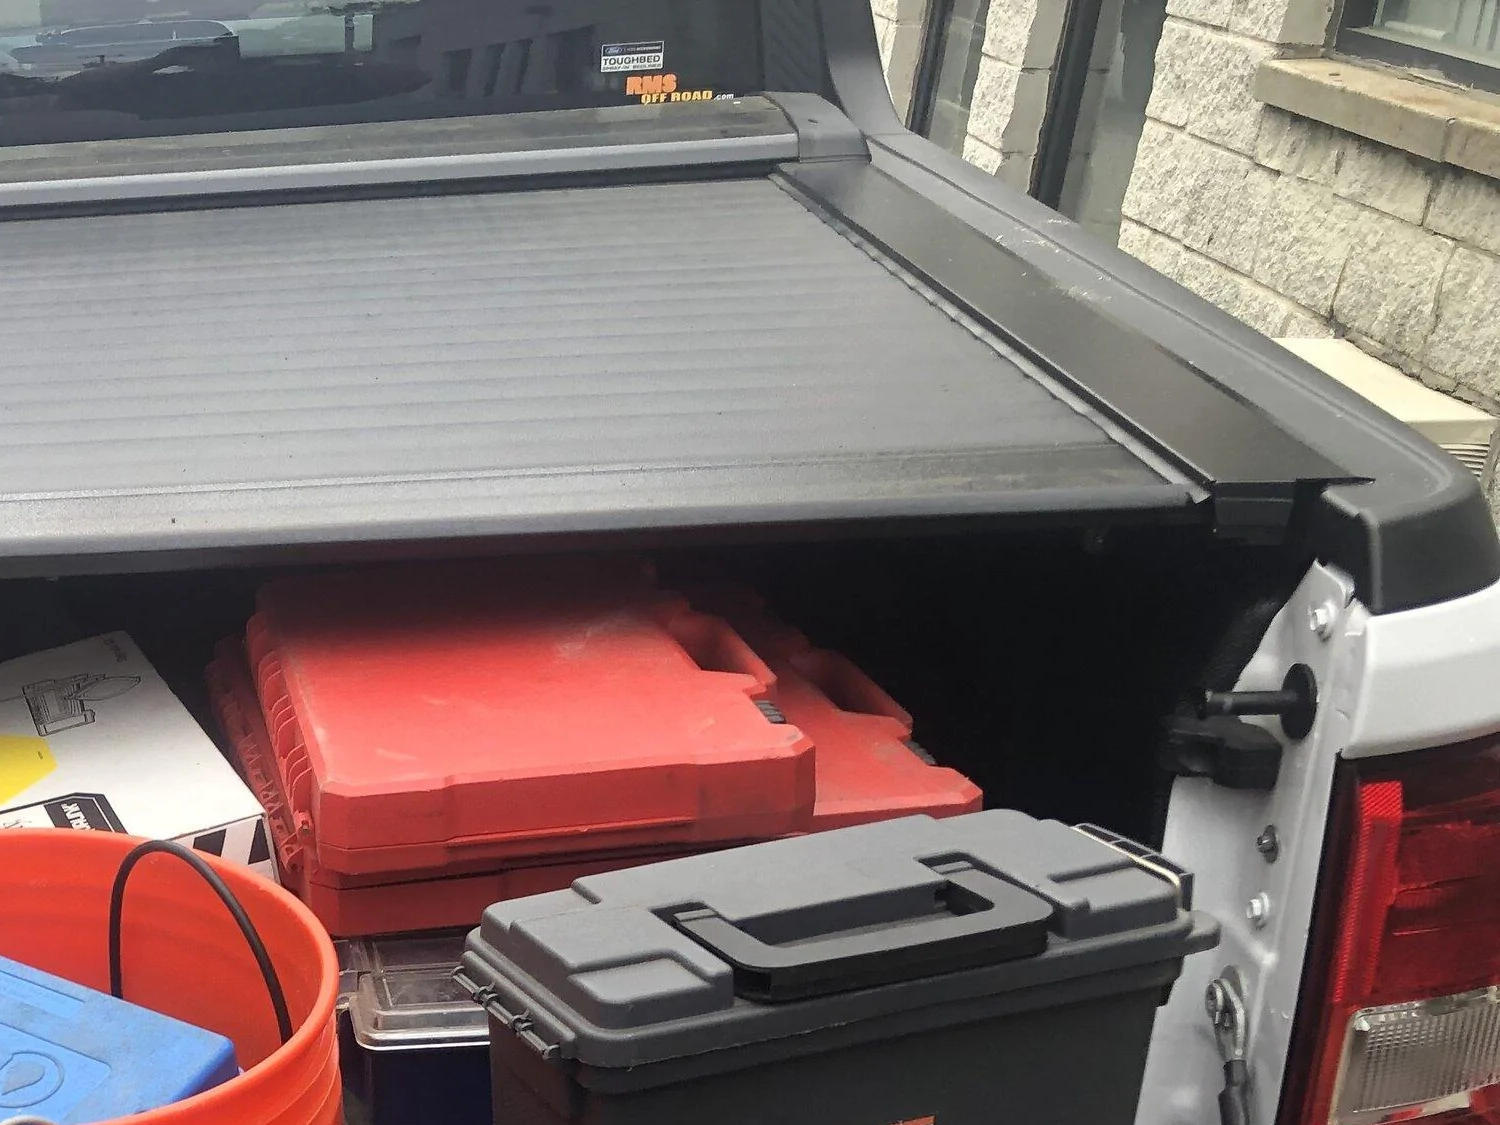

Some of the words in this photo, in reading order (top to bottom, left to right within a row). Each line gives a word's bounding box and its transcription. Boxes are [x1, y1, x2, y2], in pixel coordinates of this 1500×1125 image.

[603, 55, 661, 66] TOUGHBED
[627, 74, 678, 95] RMS
[641, 91, 667, 105] OFF
[670, 90, 713, 102] ROAD
